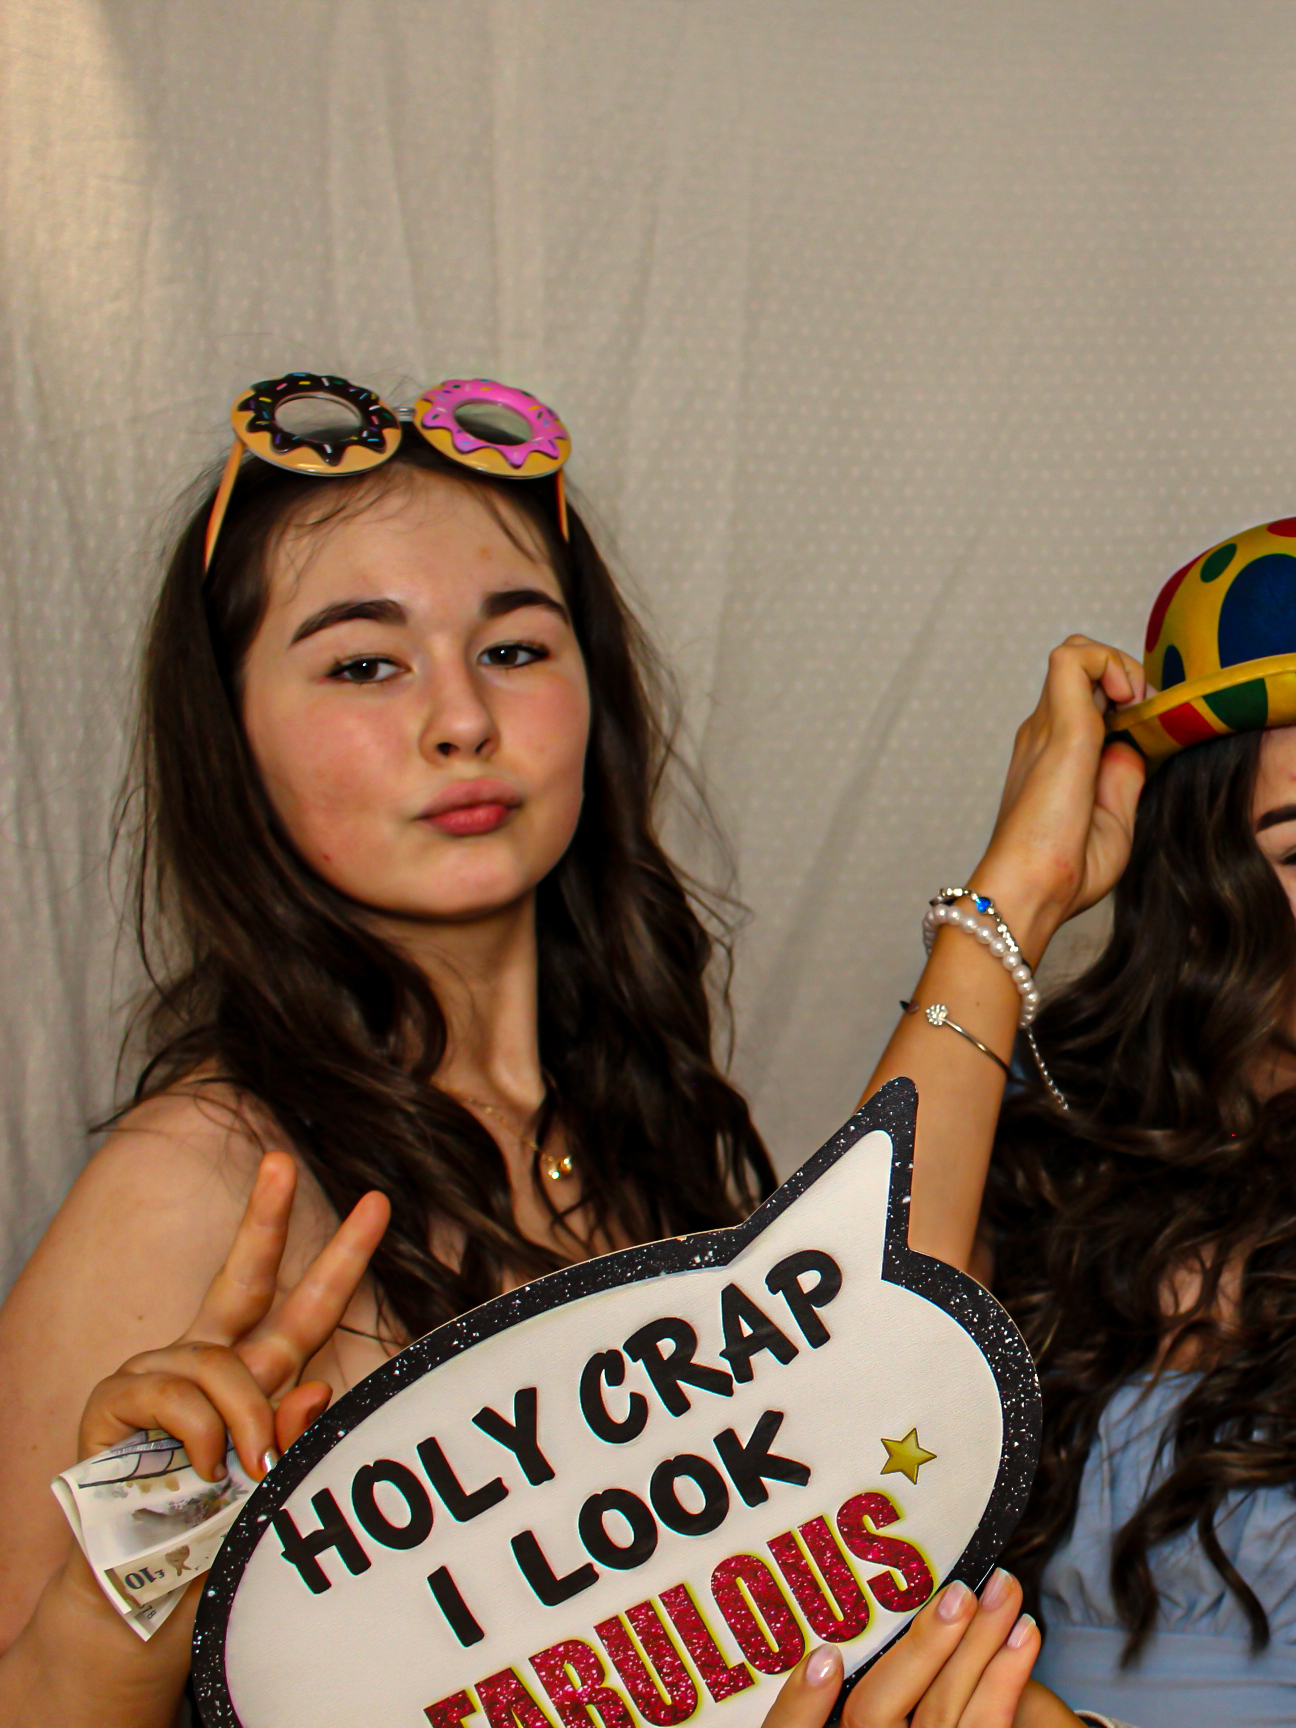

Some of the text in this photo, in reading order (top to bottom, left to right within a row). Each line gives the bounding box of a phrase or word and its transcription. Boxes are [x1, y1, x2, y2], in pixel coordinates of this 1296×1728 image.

[271, 1249, 843, 1595] HOLY CRAP
[427, 1410, 811, 1648] I LOOK
[124, 1566, 165, 1590] £10
